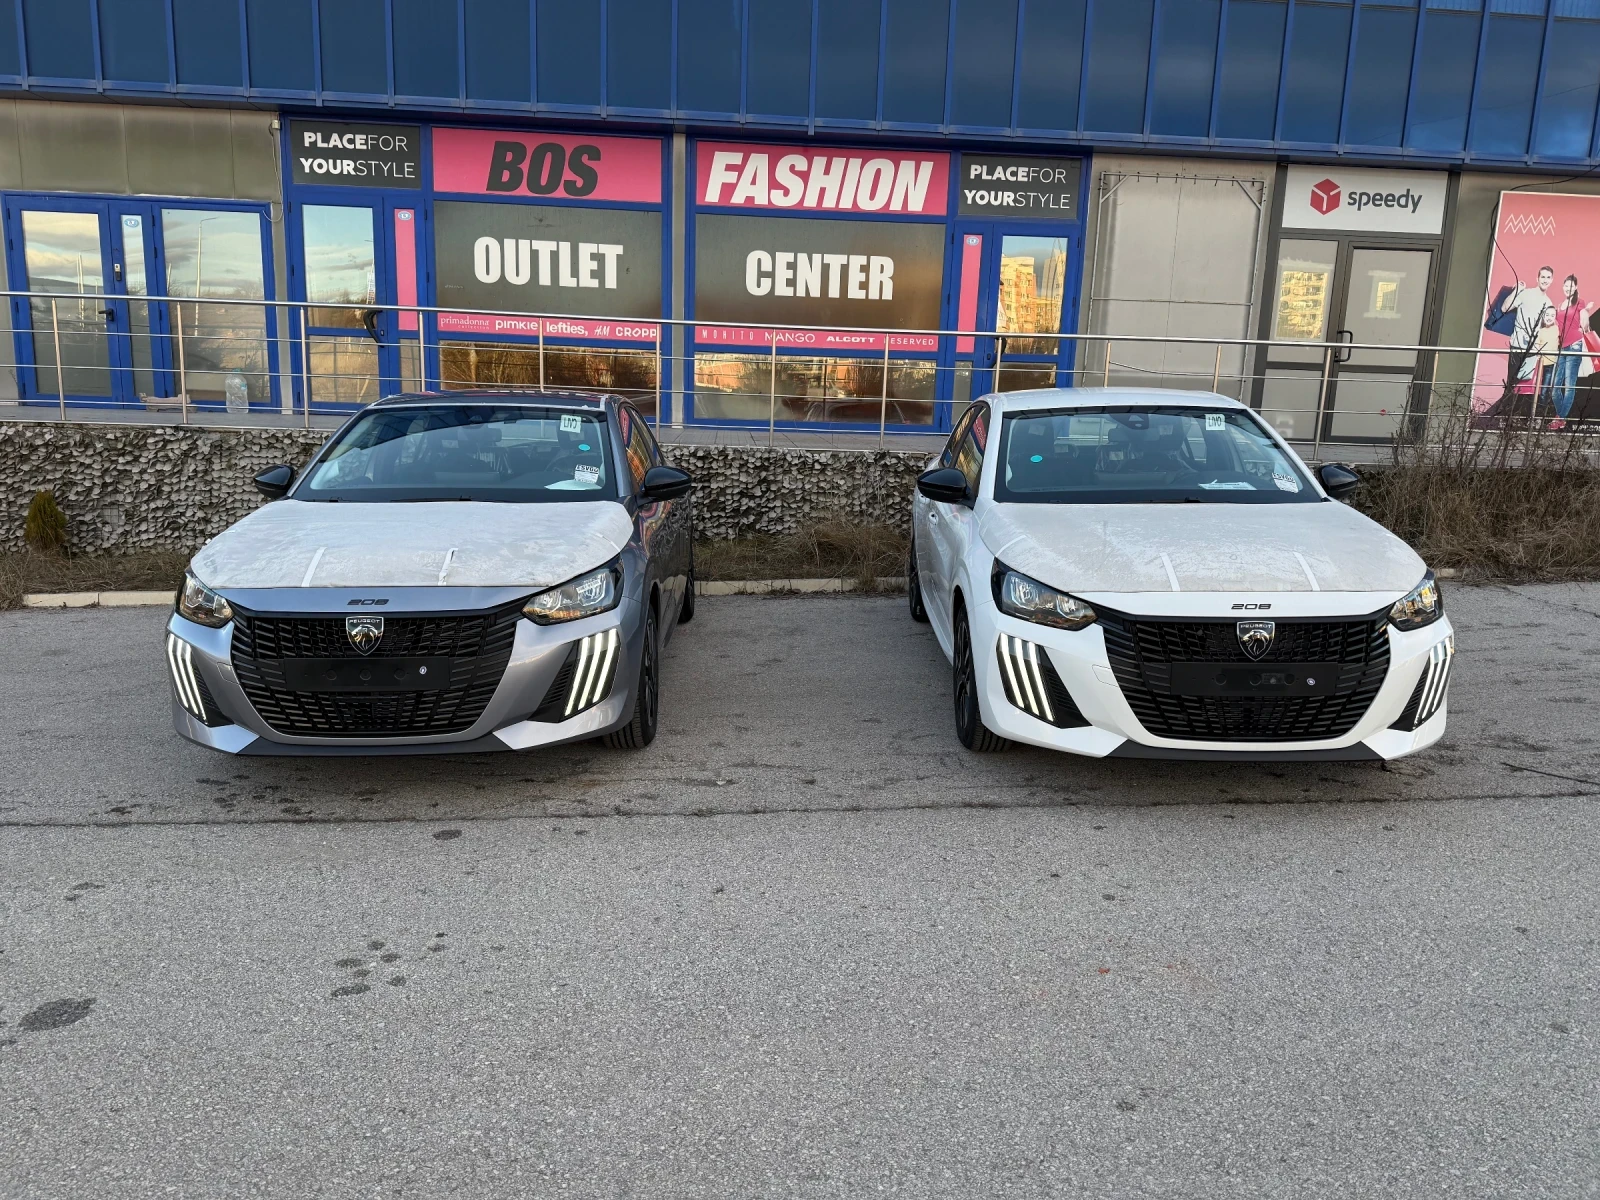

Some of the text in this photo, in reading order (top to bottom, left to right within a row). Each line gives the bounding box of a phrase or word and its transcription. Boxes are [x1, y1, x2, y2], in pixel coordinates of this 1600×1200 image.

[486, 141, 601, 196] BOS
[704, 151, 934, 212] FASHION
[1347, 188, 1423, 214] speedy
[473, 236, 624, 289] OUTLET
[745, 250, 895, 300] CENTER
[440, 315, 490, 328] primadonna
[615, 326, 657, 338] CROPP
[702, 328, 934, 346] MOHITO MANGO ALCOTT ESERVED
